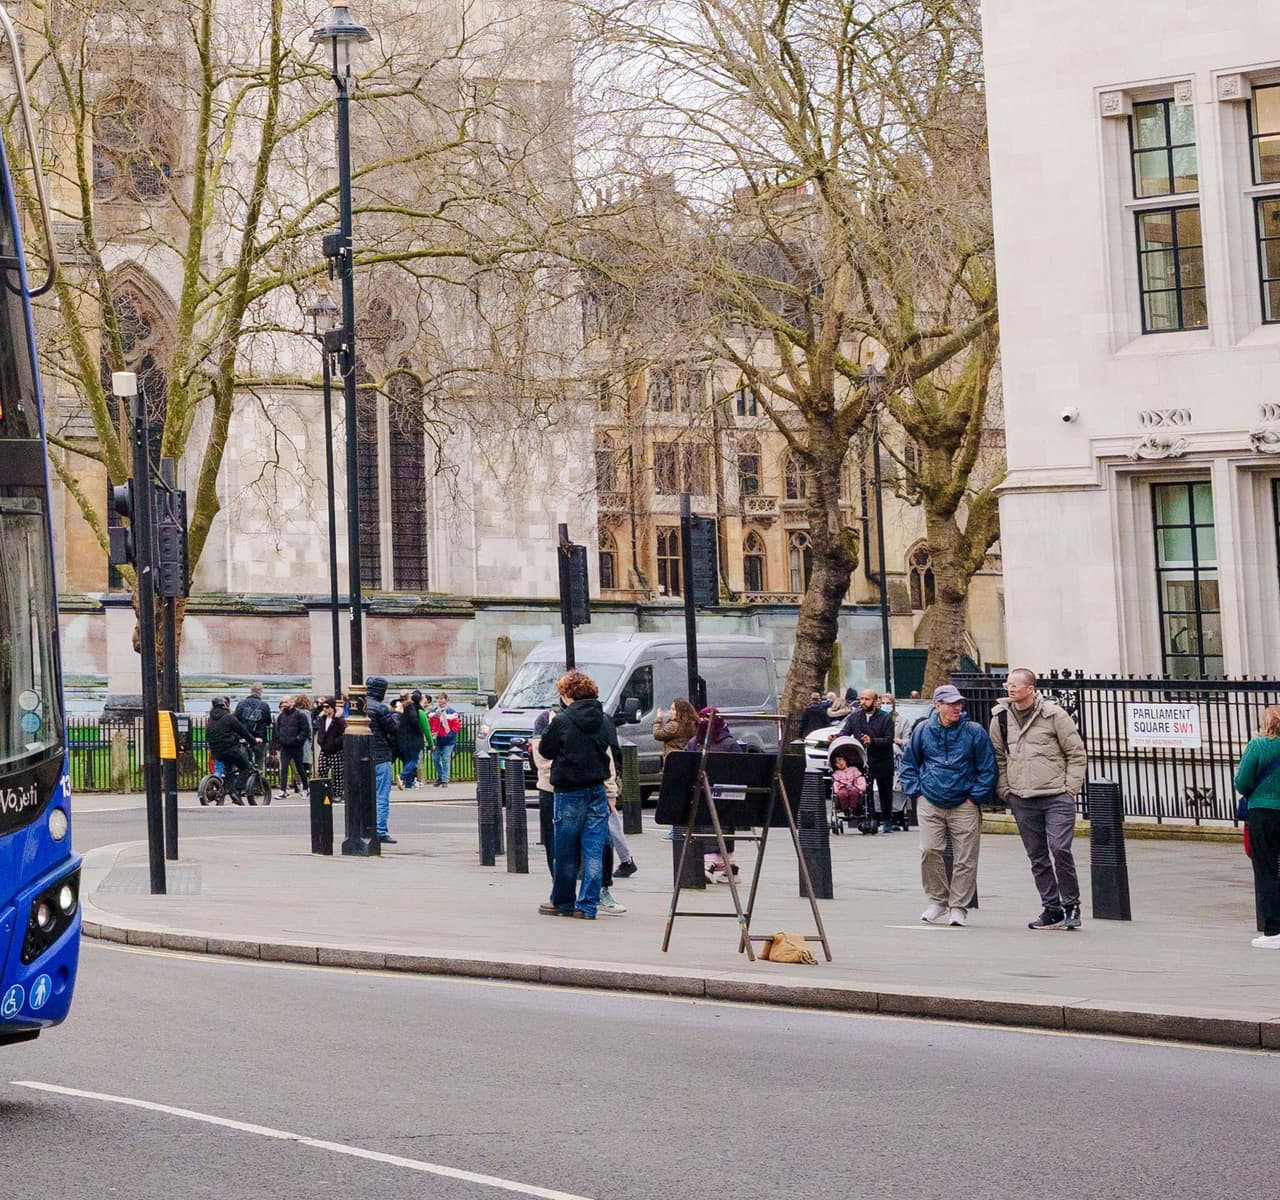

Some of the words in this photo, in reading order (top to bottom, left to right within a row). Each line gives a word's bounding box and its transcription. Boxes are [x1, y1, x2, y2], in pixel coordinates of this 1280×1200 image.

[1132, 708, 1191, 720] PARLIAMENT
[1134, 721, 1171, 733] SQUARE
[1173, 722, 1194, 734] SW1
